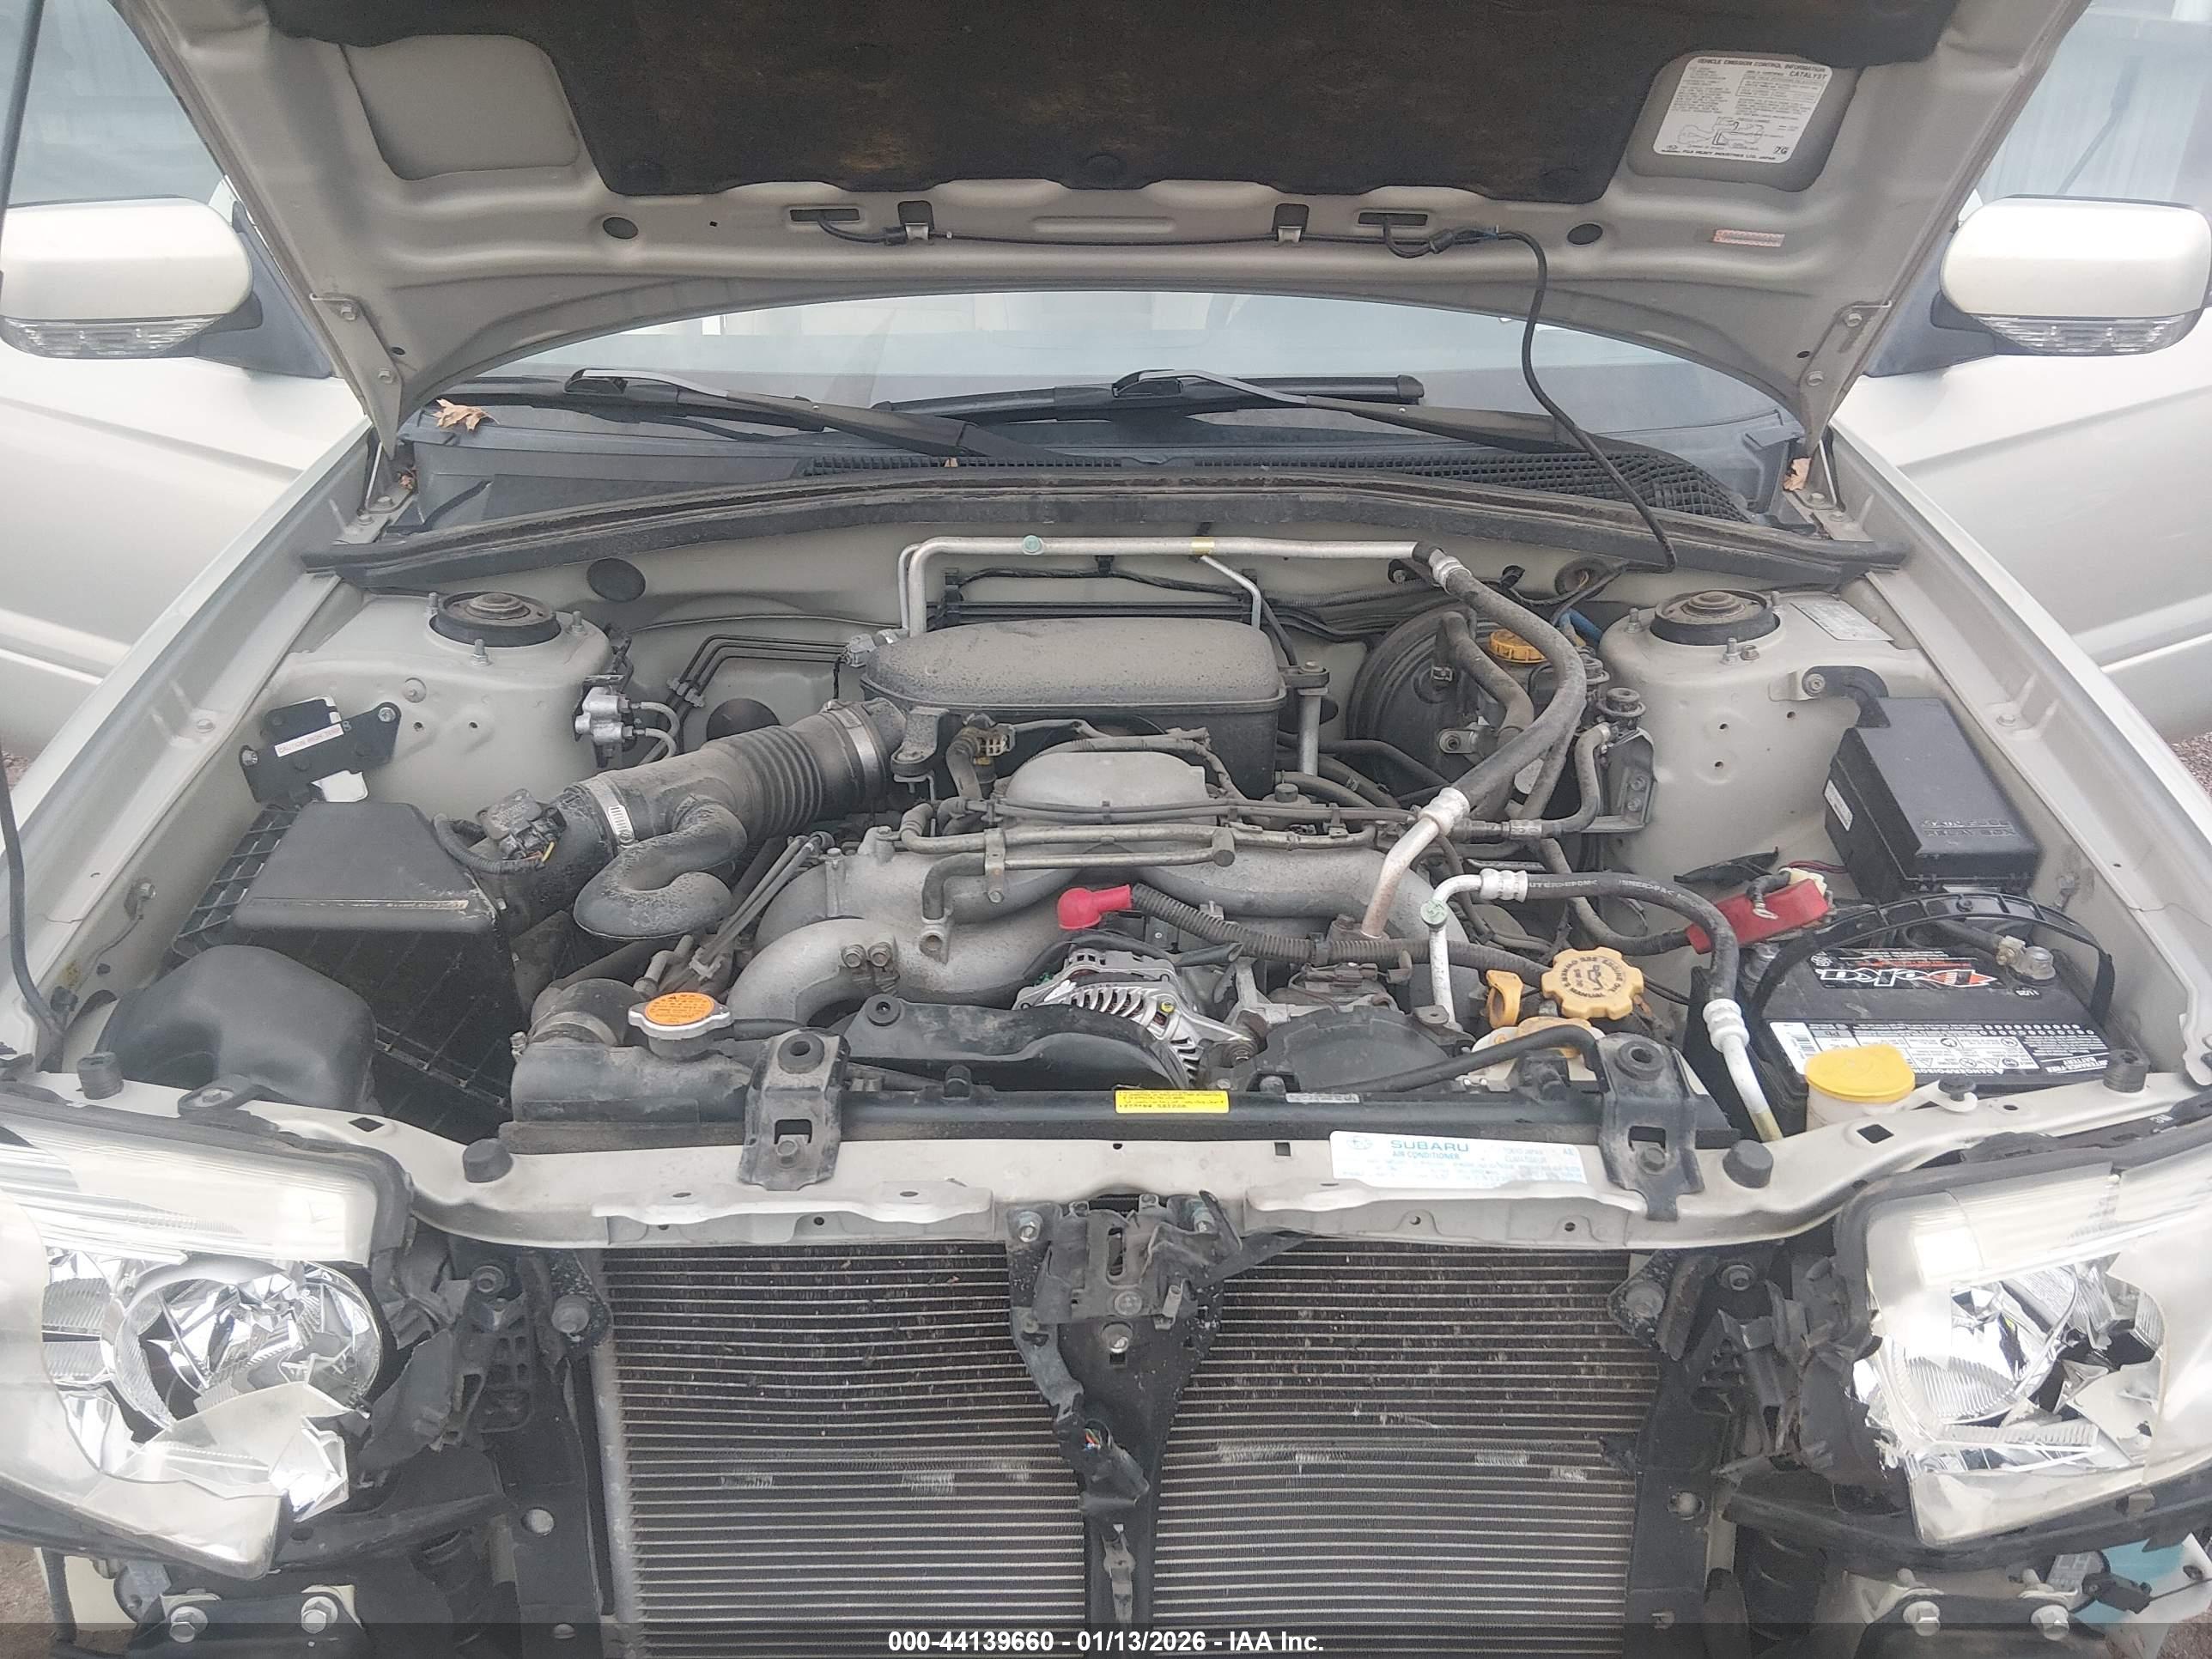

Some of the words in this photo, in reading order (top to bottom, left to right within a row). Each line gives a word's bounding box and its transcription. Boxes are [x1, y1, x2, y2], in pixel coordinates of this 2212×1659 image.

[1784, 63, 1826, 72] INFORMATION
[1789, 70, 1827, 80] CATALYST
[1390, 1139, 1469, 1152] SUBARU
[1407, 1151, 1460, 1160] CONDITIONER
